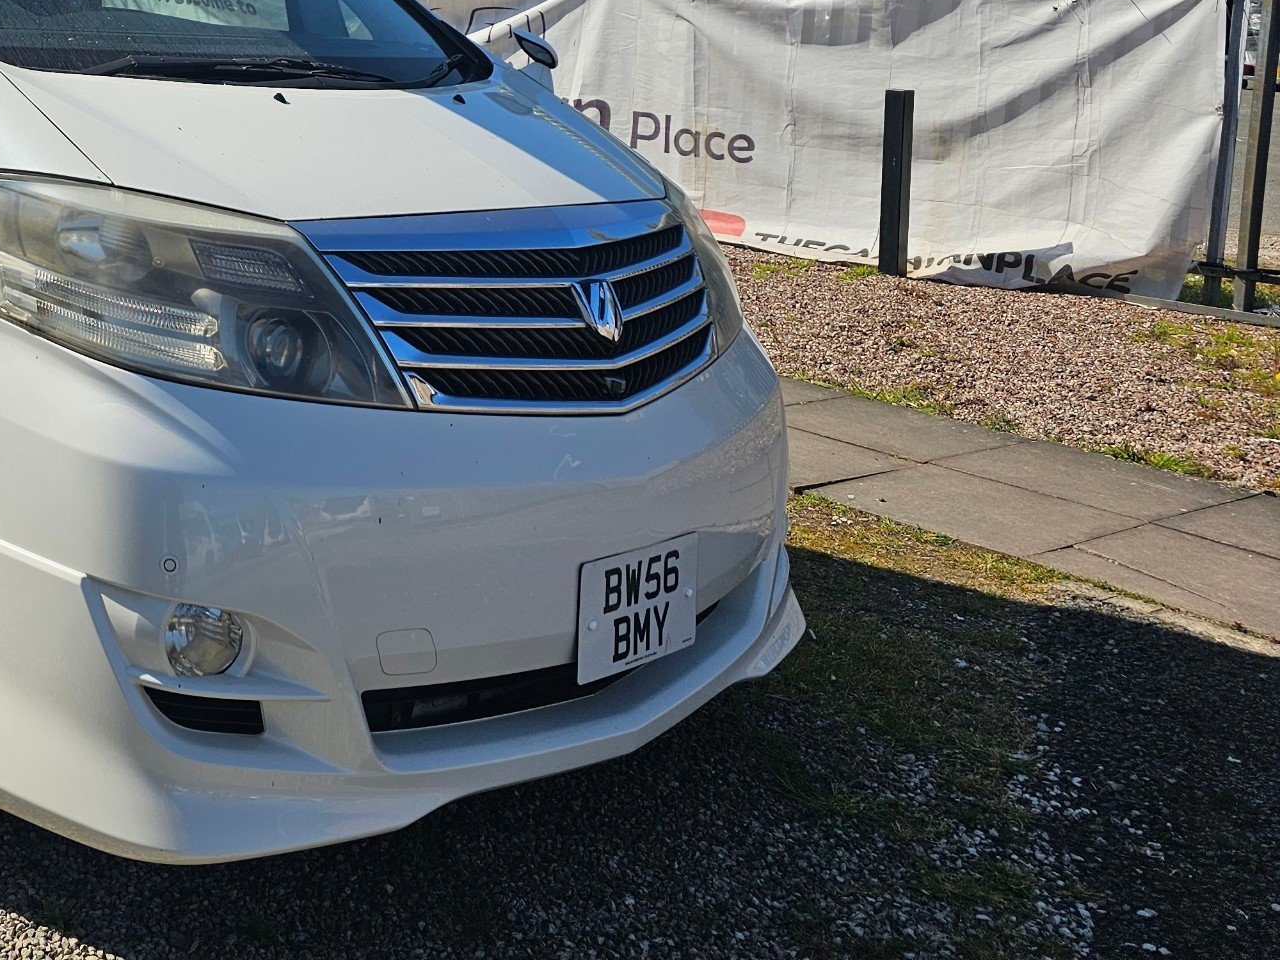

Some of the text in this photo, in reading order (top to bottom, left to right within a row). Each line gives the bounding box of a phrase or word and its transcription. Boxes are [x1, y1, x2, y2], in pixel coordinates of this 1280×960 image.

[629, 110, 756, 164] Place
[603, 549, 680, 614] BW56
[612, 601, 670, 663] BMY
